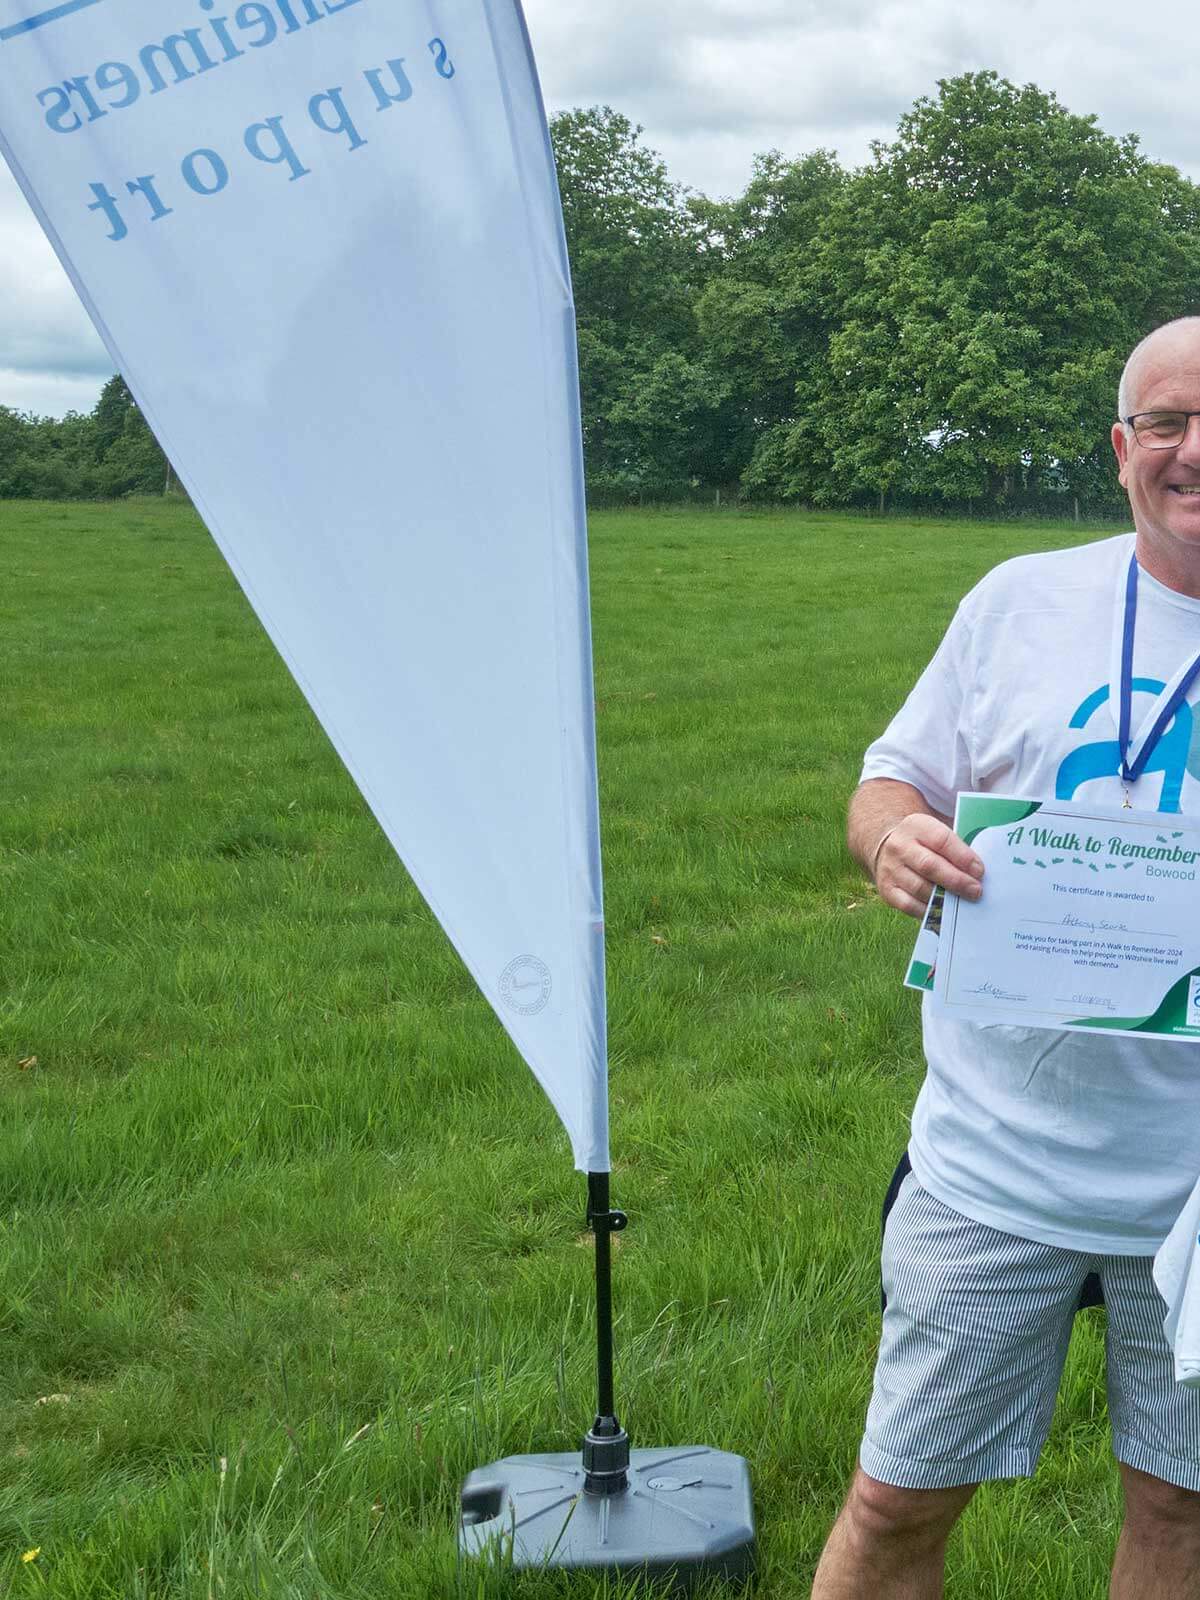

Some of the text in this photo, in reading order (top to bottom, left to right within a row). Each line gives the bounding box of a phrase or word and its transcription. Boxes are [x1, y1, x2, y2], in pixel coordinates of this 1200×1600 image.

[1007, 826, 1200, 864] A Walk to Remember
[1145, 865, 1196, 881] Bowood
[1052, 884, 1155, 902] This certificate is awarded to
[1014, 932, 1033, 941] Thank
